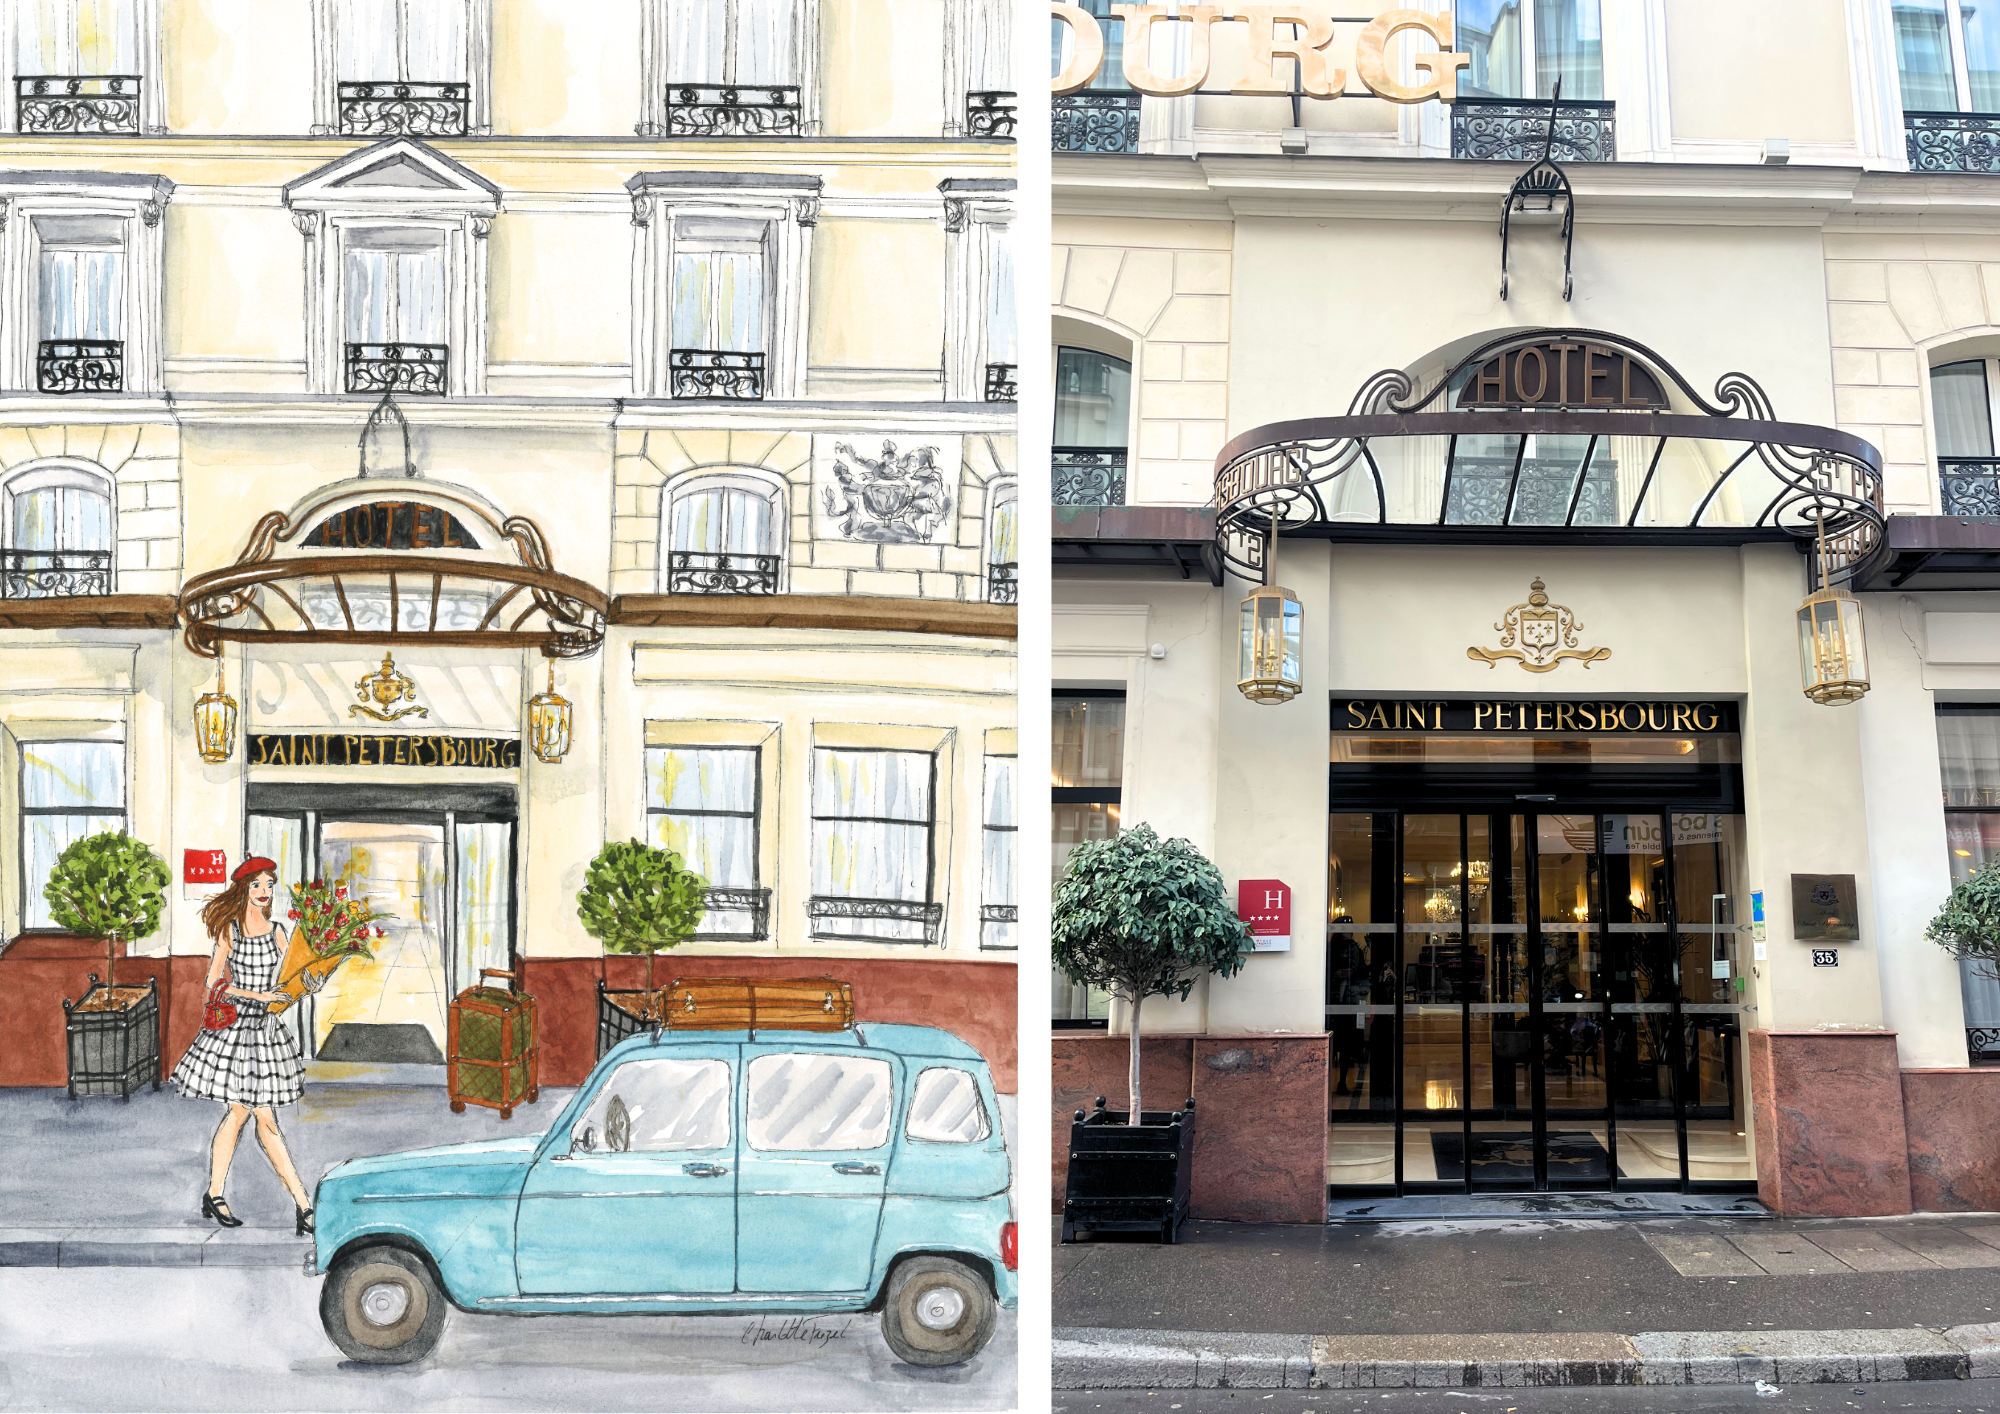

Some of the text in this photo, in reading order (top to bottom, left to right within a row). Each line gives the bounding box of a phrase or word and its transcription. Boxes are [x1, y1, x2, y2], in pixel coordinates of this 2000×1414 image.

[1478, 344, 1648, 404] HOTEL
[322, 502, 462, 549] HOTEL
[1348, 700, 1720, 732] SAINT PETERSBOURG
[253, 734, 516, 768] SAINT PETERSBOURG
[211, 853, 223, 865] H
[1263, 890, 1284, 909] H
[1816, 952, 1834, 964] 35
